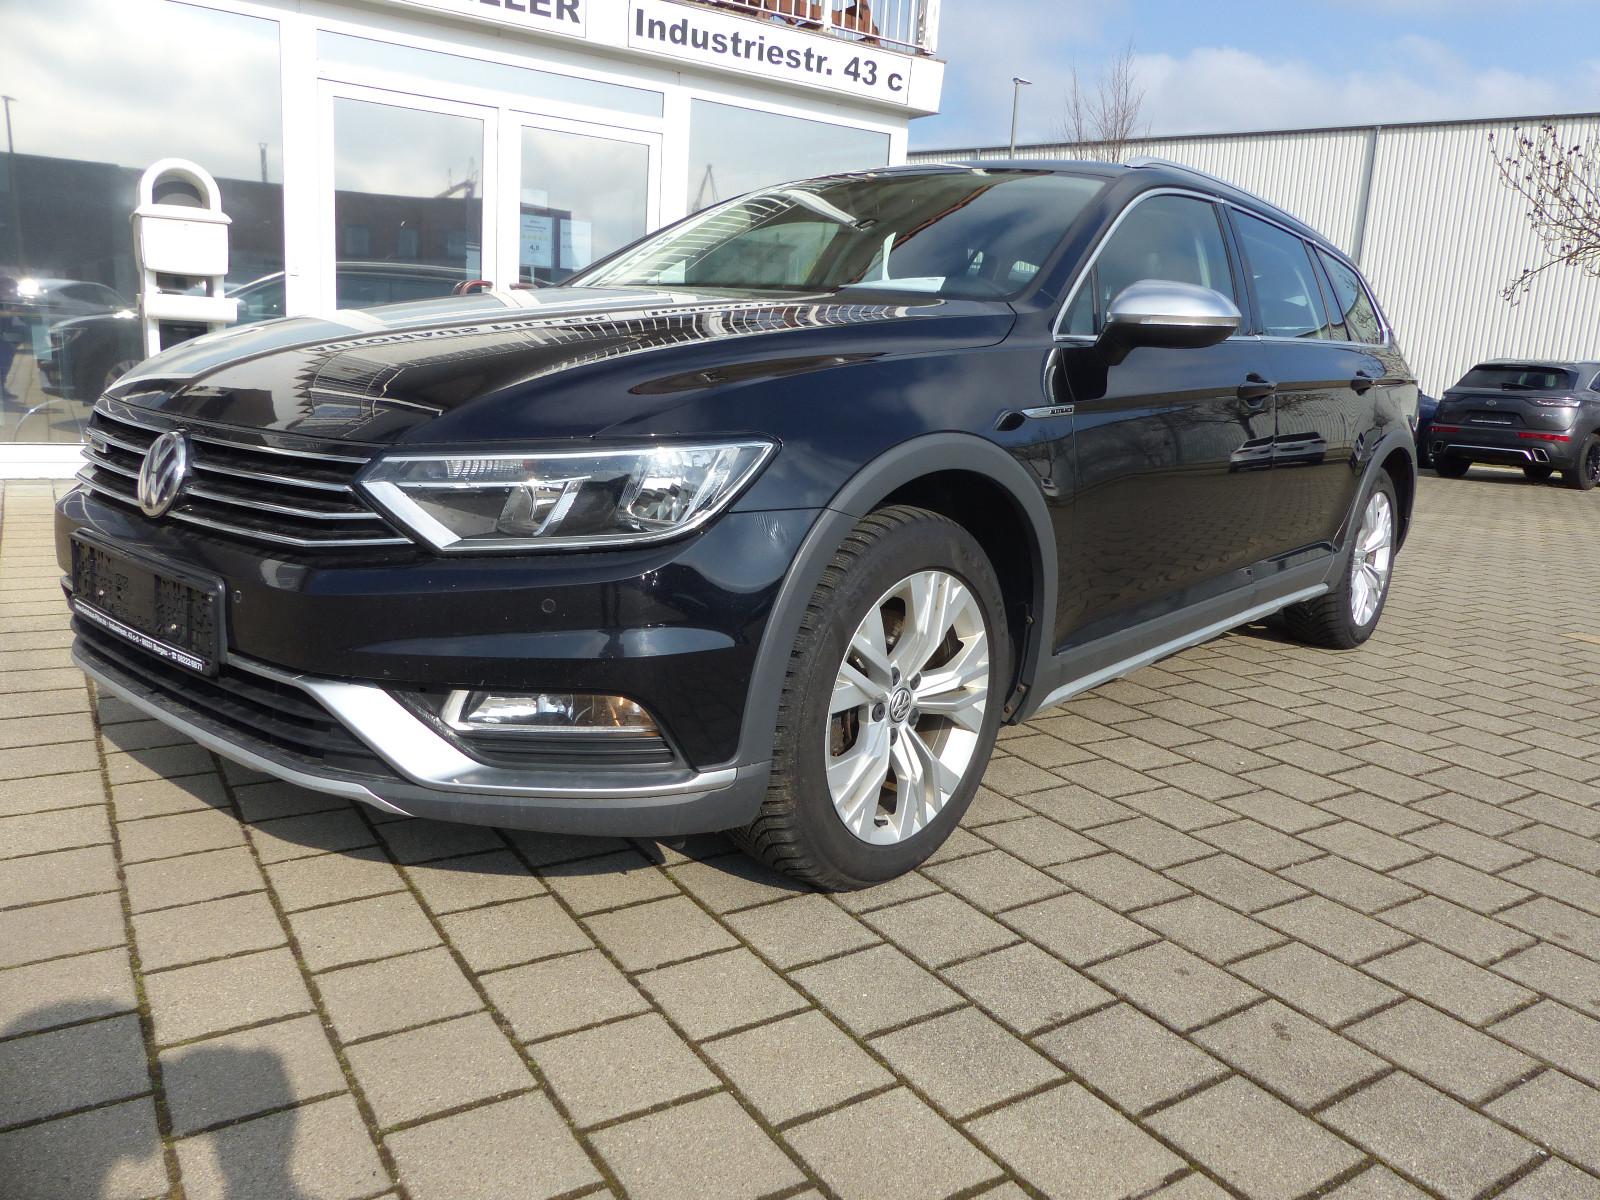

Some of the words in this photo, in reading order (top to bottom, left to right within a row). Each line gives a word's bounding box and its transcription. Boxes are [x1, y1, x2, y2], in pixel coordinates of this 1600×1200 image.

[635, 8, 833, 75] Industriestr.
[844, 56, 877, 86] 43
[887, 72, 903, 92] c
